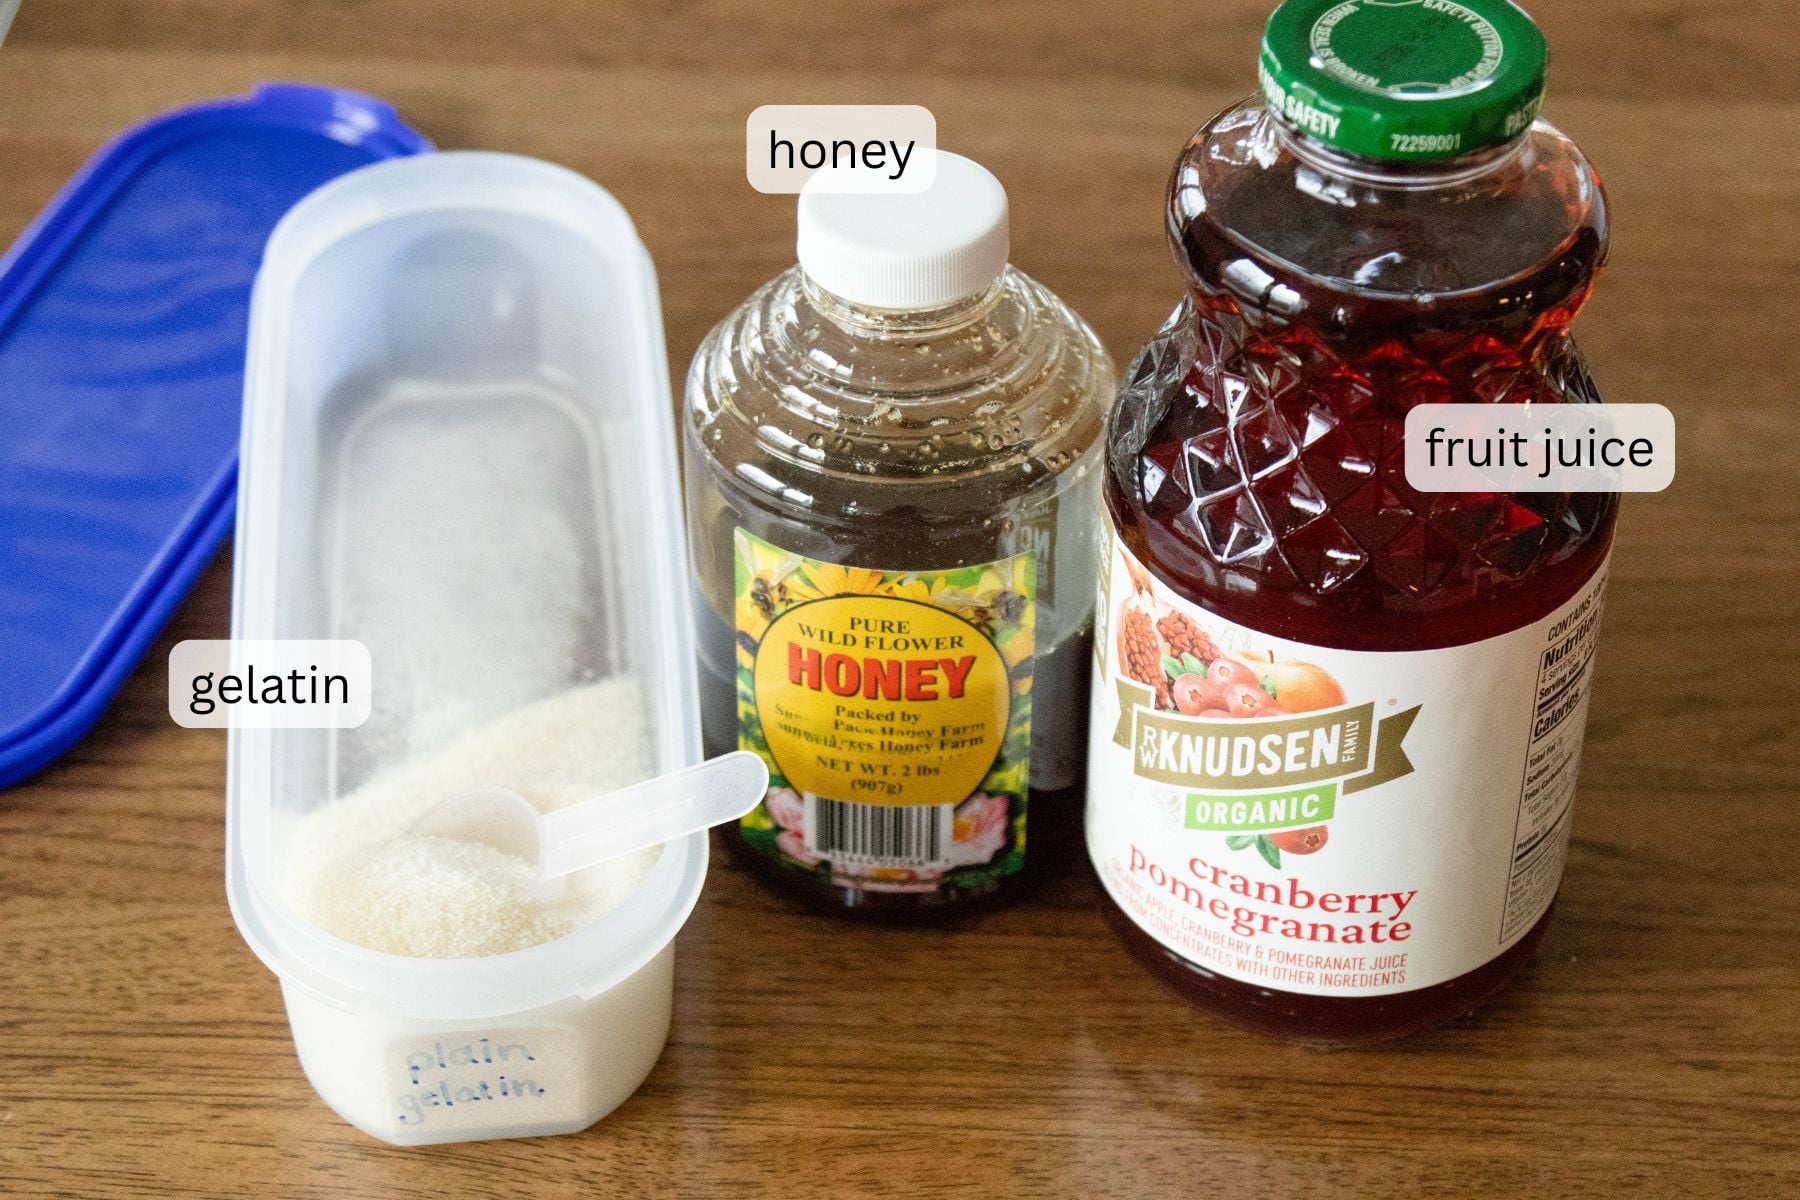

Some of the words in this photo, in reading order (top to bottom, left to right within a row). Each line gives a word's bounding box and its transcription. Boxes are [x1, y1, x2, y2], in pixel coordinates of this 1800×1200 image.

[1320, 3, 1360, 27] WHEN
[1315, 25, 1333, 48] SEAL
[1318, 48, 1335, 58] IS
[1470, 21, 1500, 57] BUTTON
[1325, 57, 1380, 88] BROKEN
[1285, 95, 1341, 139] SAFETY
[1391, 133, 1461, 152] 72259001
[849, 616, 911, 635] PURE
[1548, 594, 1592, 641] CONTAINS
[797, 623, 858, 647] WILD
[863, 634, 964, 652] FLOWER
[1543, 608, 1598, 670] Nutrition
[787, 641, 977, 702] HONEY
[1539, 673, 1567, 701] Serving
[835, 705, 895, 722] Packed
[901, 711, 921, 725] by
[1534, 686, 1580, 738] Calories
[939, 736, 984, 751] Farm
[1160, 723, 1341, 777] KNUDSEN
[1342, 720, 1360, 762] FAMILY
[815, 755, 852, 772] NET
[860, 763, 896, 777] WT.
[902, 765, 912, 777] 2
[916, 763, 941, 777] lbs
[851, 779, 904, 795] (907g)
[1195, 794, 1320, 825] ORGANIC
[1128, 843, 1412, 945] pomegranate
[1188, 855, 1419, 921] cranberry
[1146, 893, 1178, 926] APPLE,
[1181, 916, 1252, 956] CRANBERRY
[1255, 945, 1264, 959] &
[1268, 949, 1368, 971] POMEGRANATE
[1370, 953, 1408, 970] JUICE
[1150, 913, 1234, 967] CONCENTRATES
[1236, 957, 1268, 977] WITH
[1272, 966, 1315, 985] OTHER
[1319, 970, 1407, 988] INGREDIENTS
[406, 1038, 535, 1085] plain
[398, 1075, 545, 1126] gelatin
